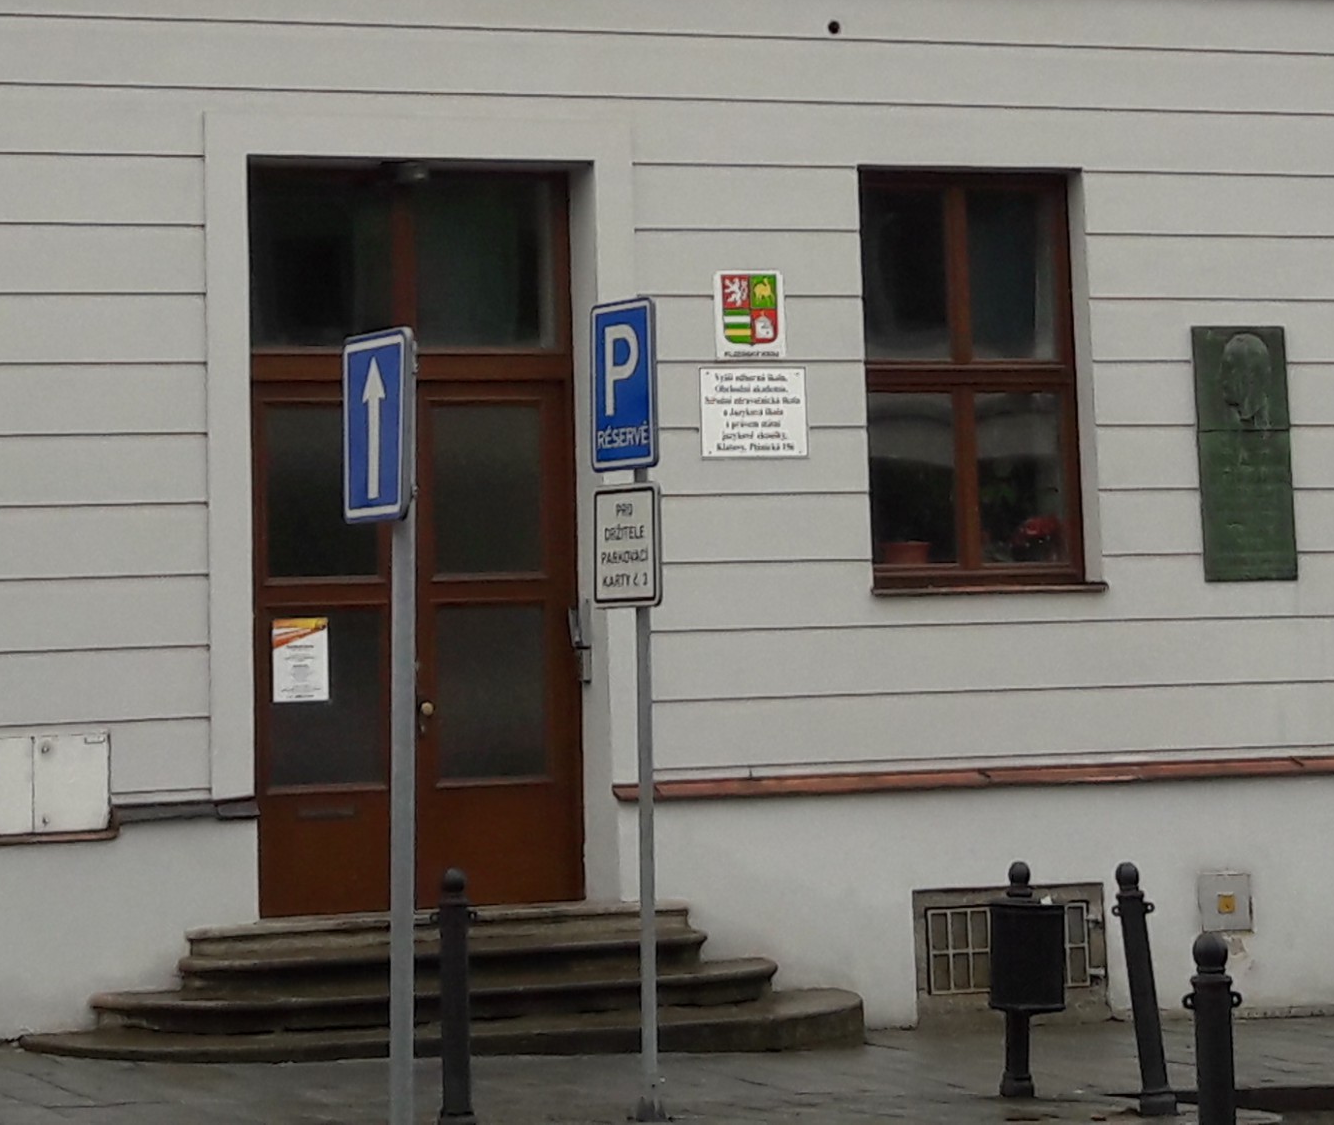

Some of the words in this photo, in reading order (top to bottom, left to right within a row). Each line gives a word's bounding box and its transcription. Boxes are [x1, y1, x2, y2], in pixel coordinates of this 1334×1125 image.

[604, 324, 639, 416] P
[616, 503, 633, 516] PRO
[604, 524, 644, 541] DRŽITELE
